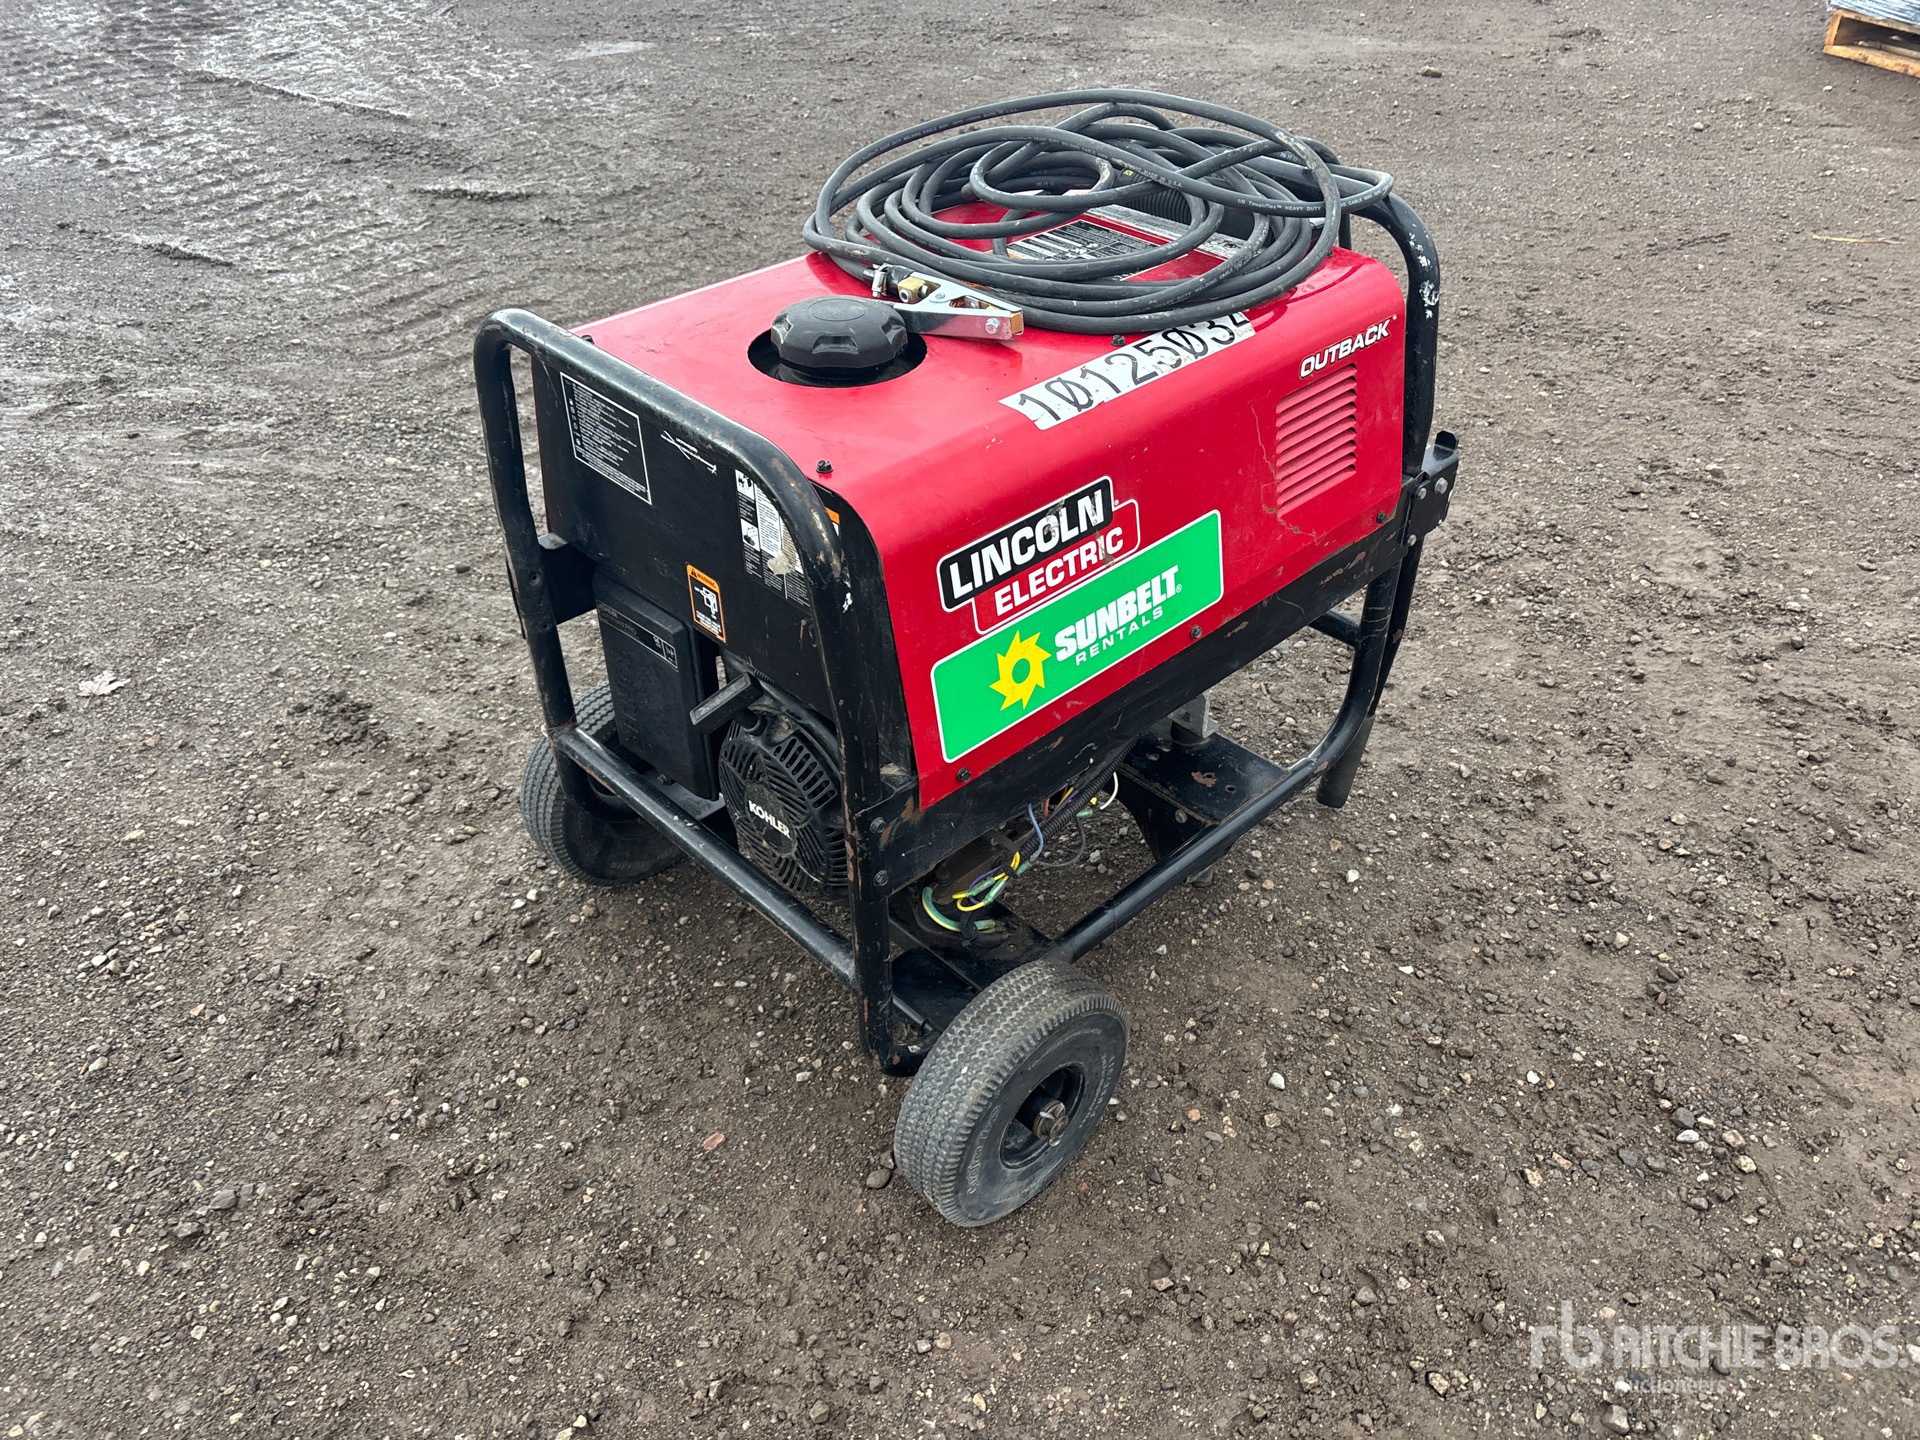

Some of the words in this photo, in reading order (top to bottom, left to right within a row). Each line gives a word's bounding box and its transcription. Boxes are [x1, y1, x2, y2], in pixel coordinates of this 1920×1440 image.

[1347, 197, 1363, 207] CABLE
[1300, 317, 1392, 380] OUTBACK
[949, 488, 1105, 600] LINCOLN
[994, 526, 1124, 617] ELECTRIC
[1054, 565, 1179, 662] SUNBELT
[1075, 605, 1163, 667] RENTALS
[748, 800, 792, 841] KOHLER
